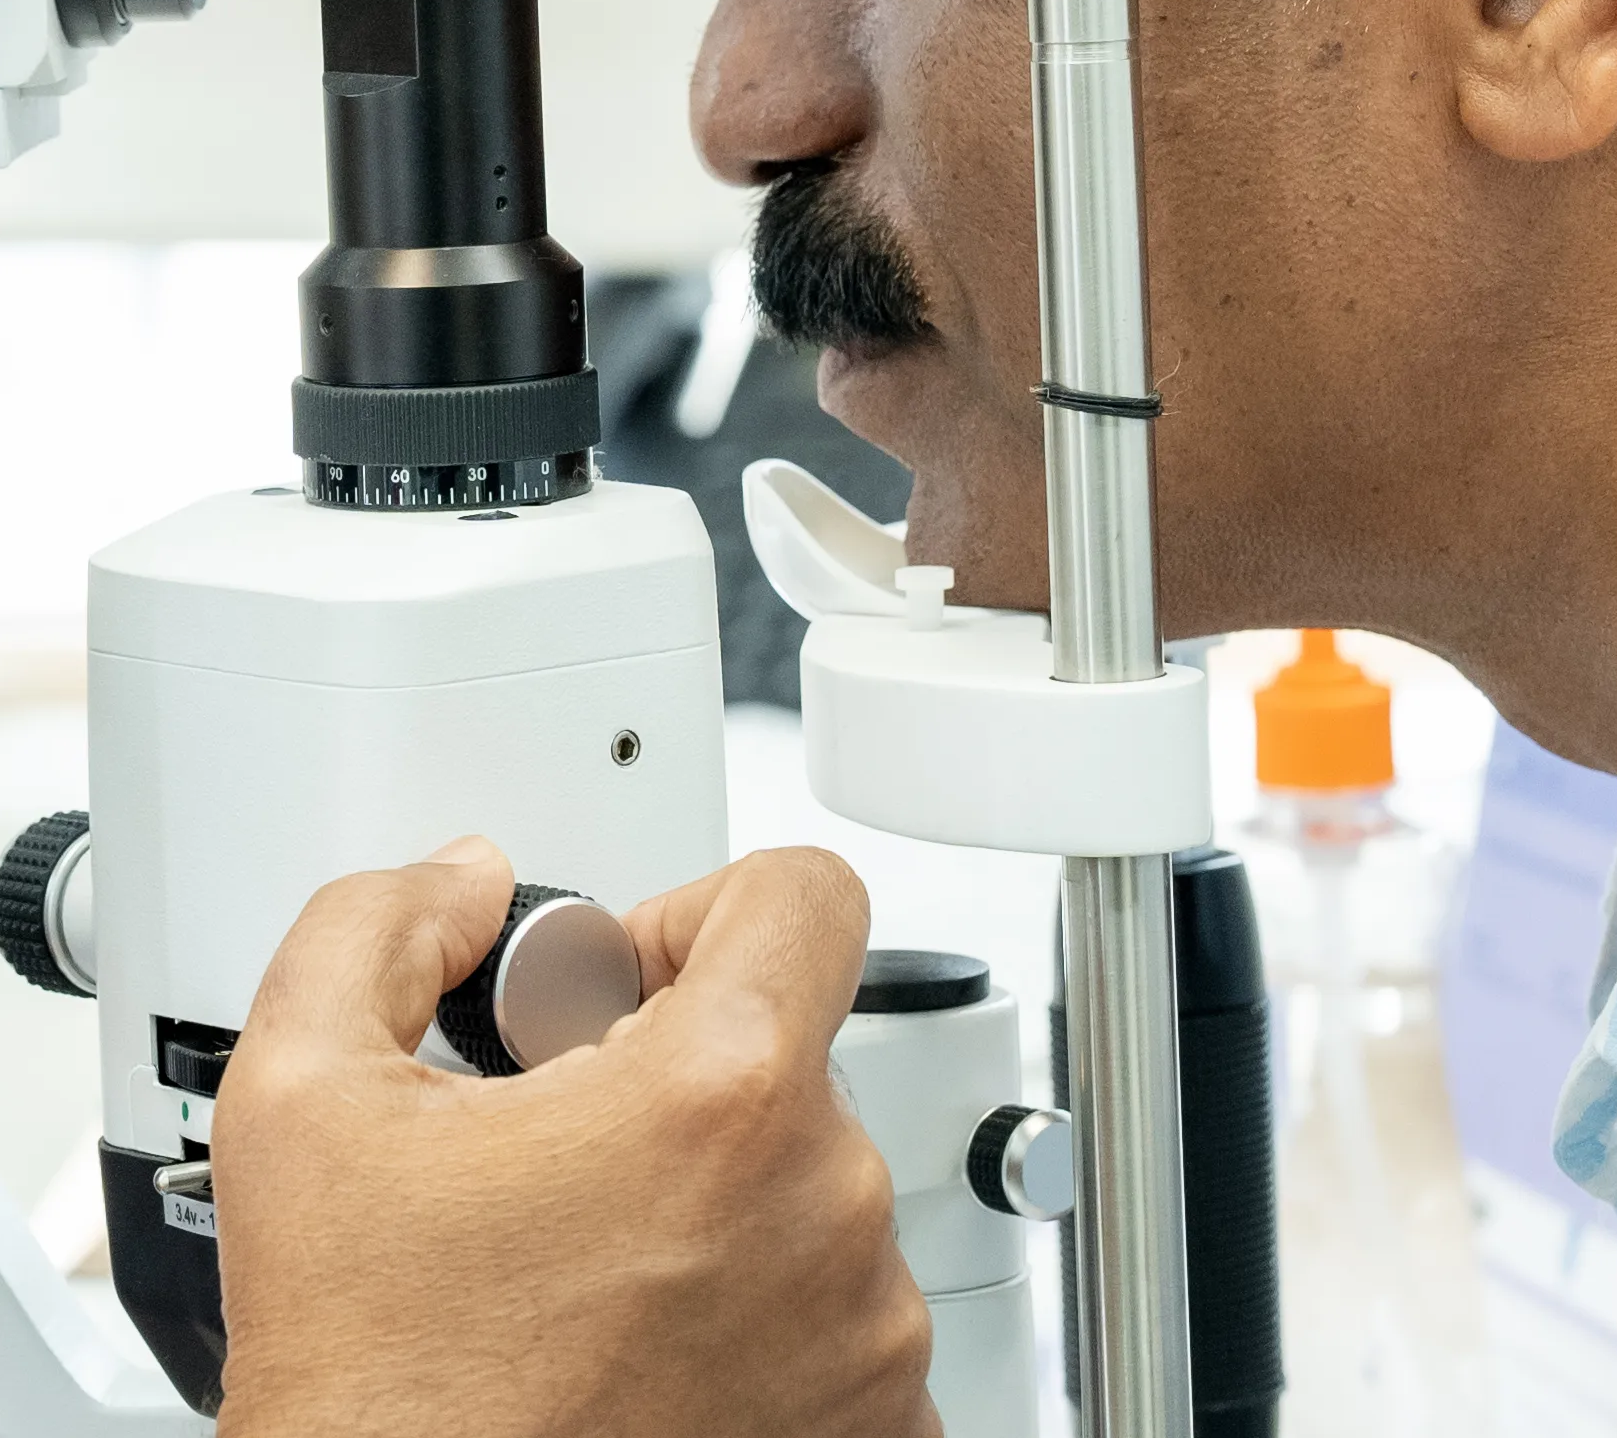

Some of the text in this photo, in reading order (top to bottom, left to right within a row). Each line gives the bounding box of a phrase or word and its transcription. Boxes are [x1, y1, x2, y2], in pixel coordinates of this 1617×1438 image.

[329, 461, 550, 484] 90 60 30 0
